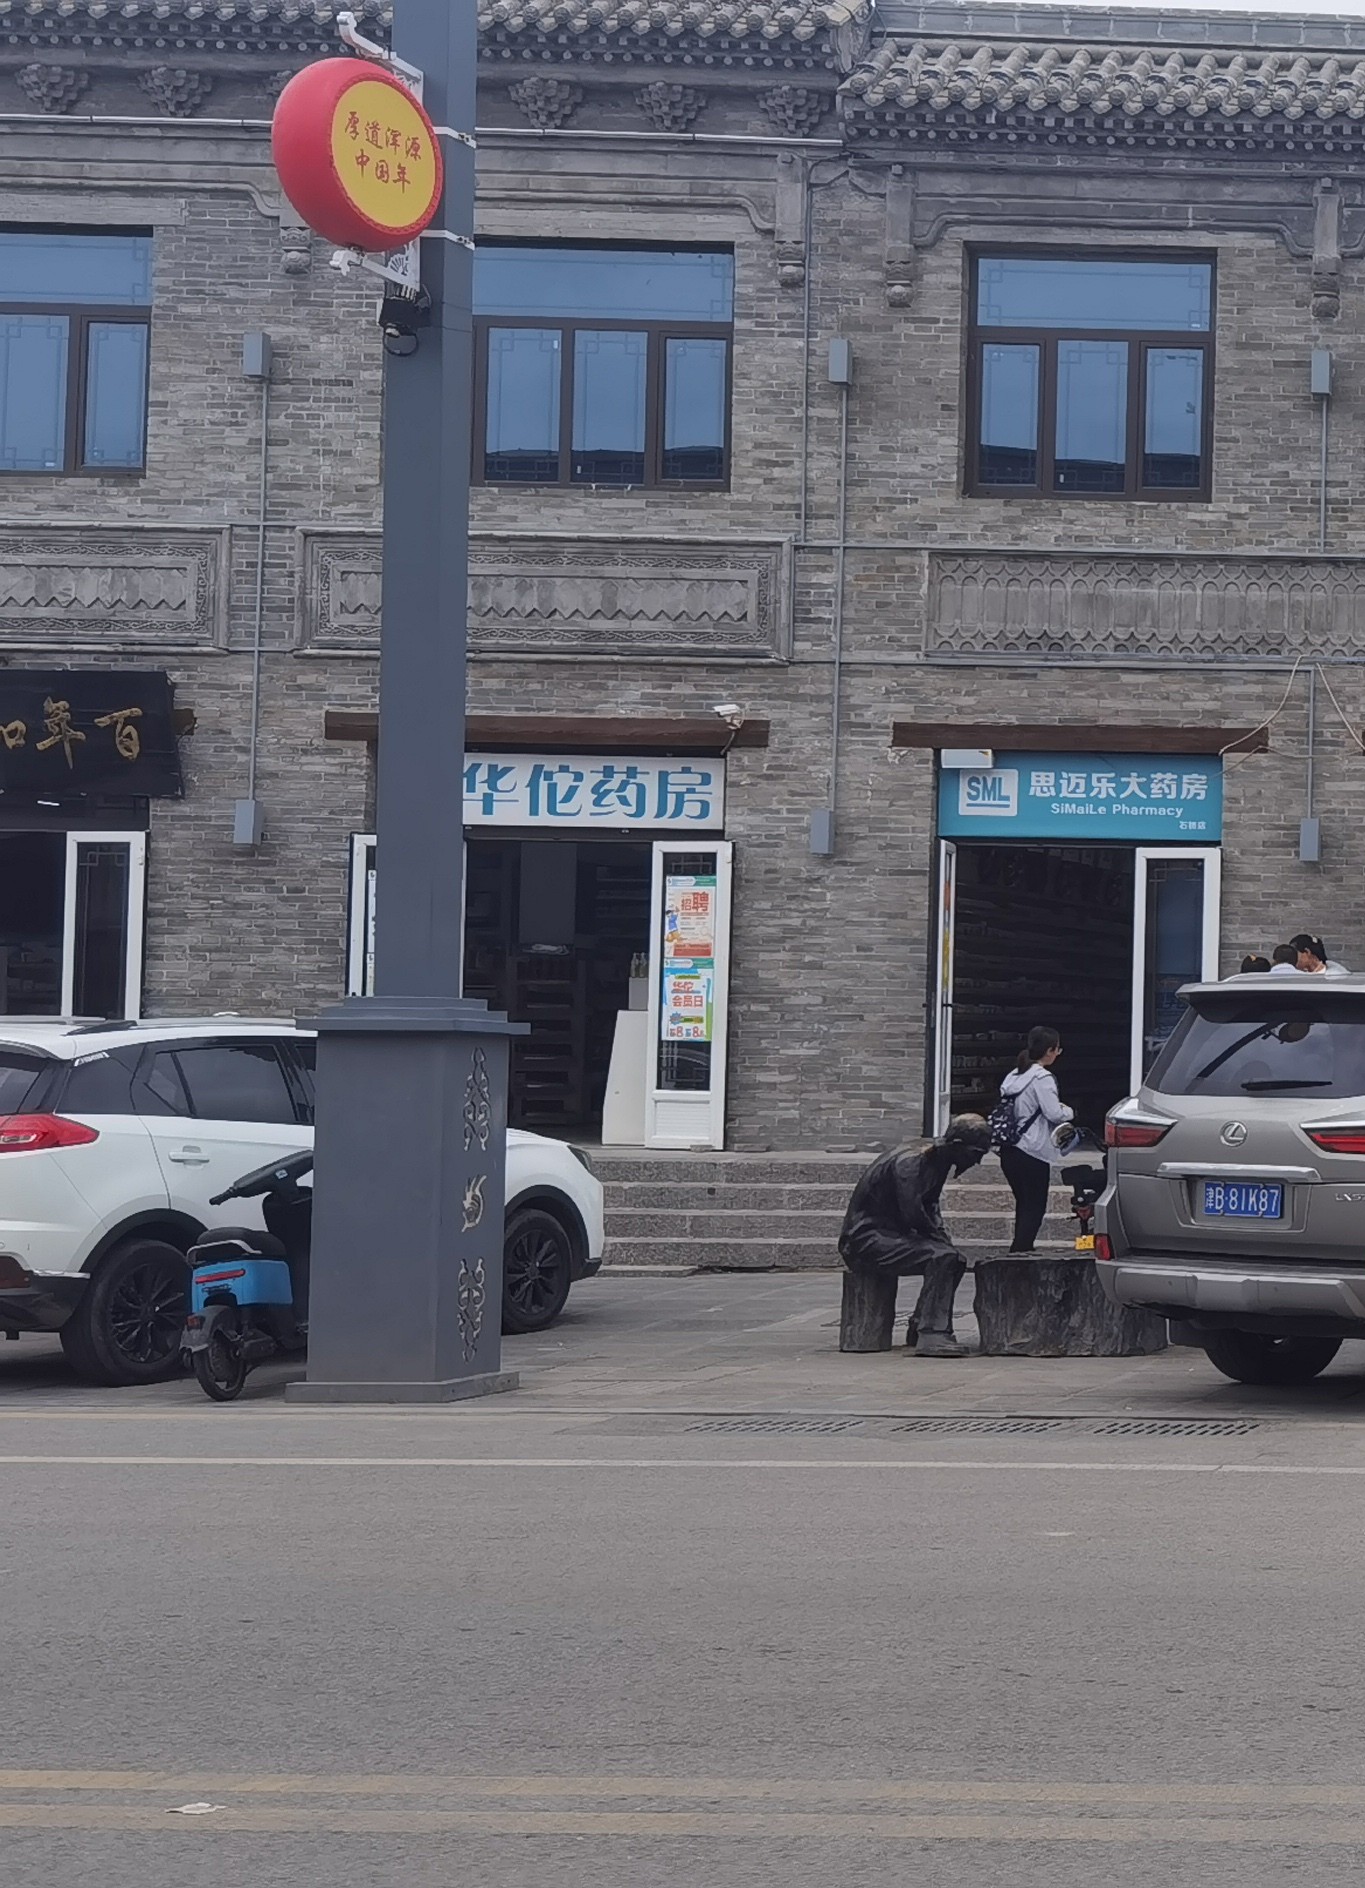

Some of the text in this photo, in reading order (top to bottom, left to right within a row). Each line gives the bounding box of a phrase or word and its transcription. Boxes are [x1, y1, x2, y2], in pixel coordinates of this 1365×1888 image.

[344, 111, 421, 161] 厚道浑源
[355, 149, 411, 194] 中国年
[463, 762, 713, 820] 华佗药房
[966, 775, 1011, 801] SML
[1028, 771, 1209, 801] 思迈乐大药房
[1112, 803, 1184, 818] Pharmacy
[672, 995, 704, 1008] 会员日
